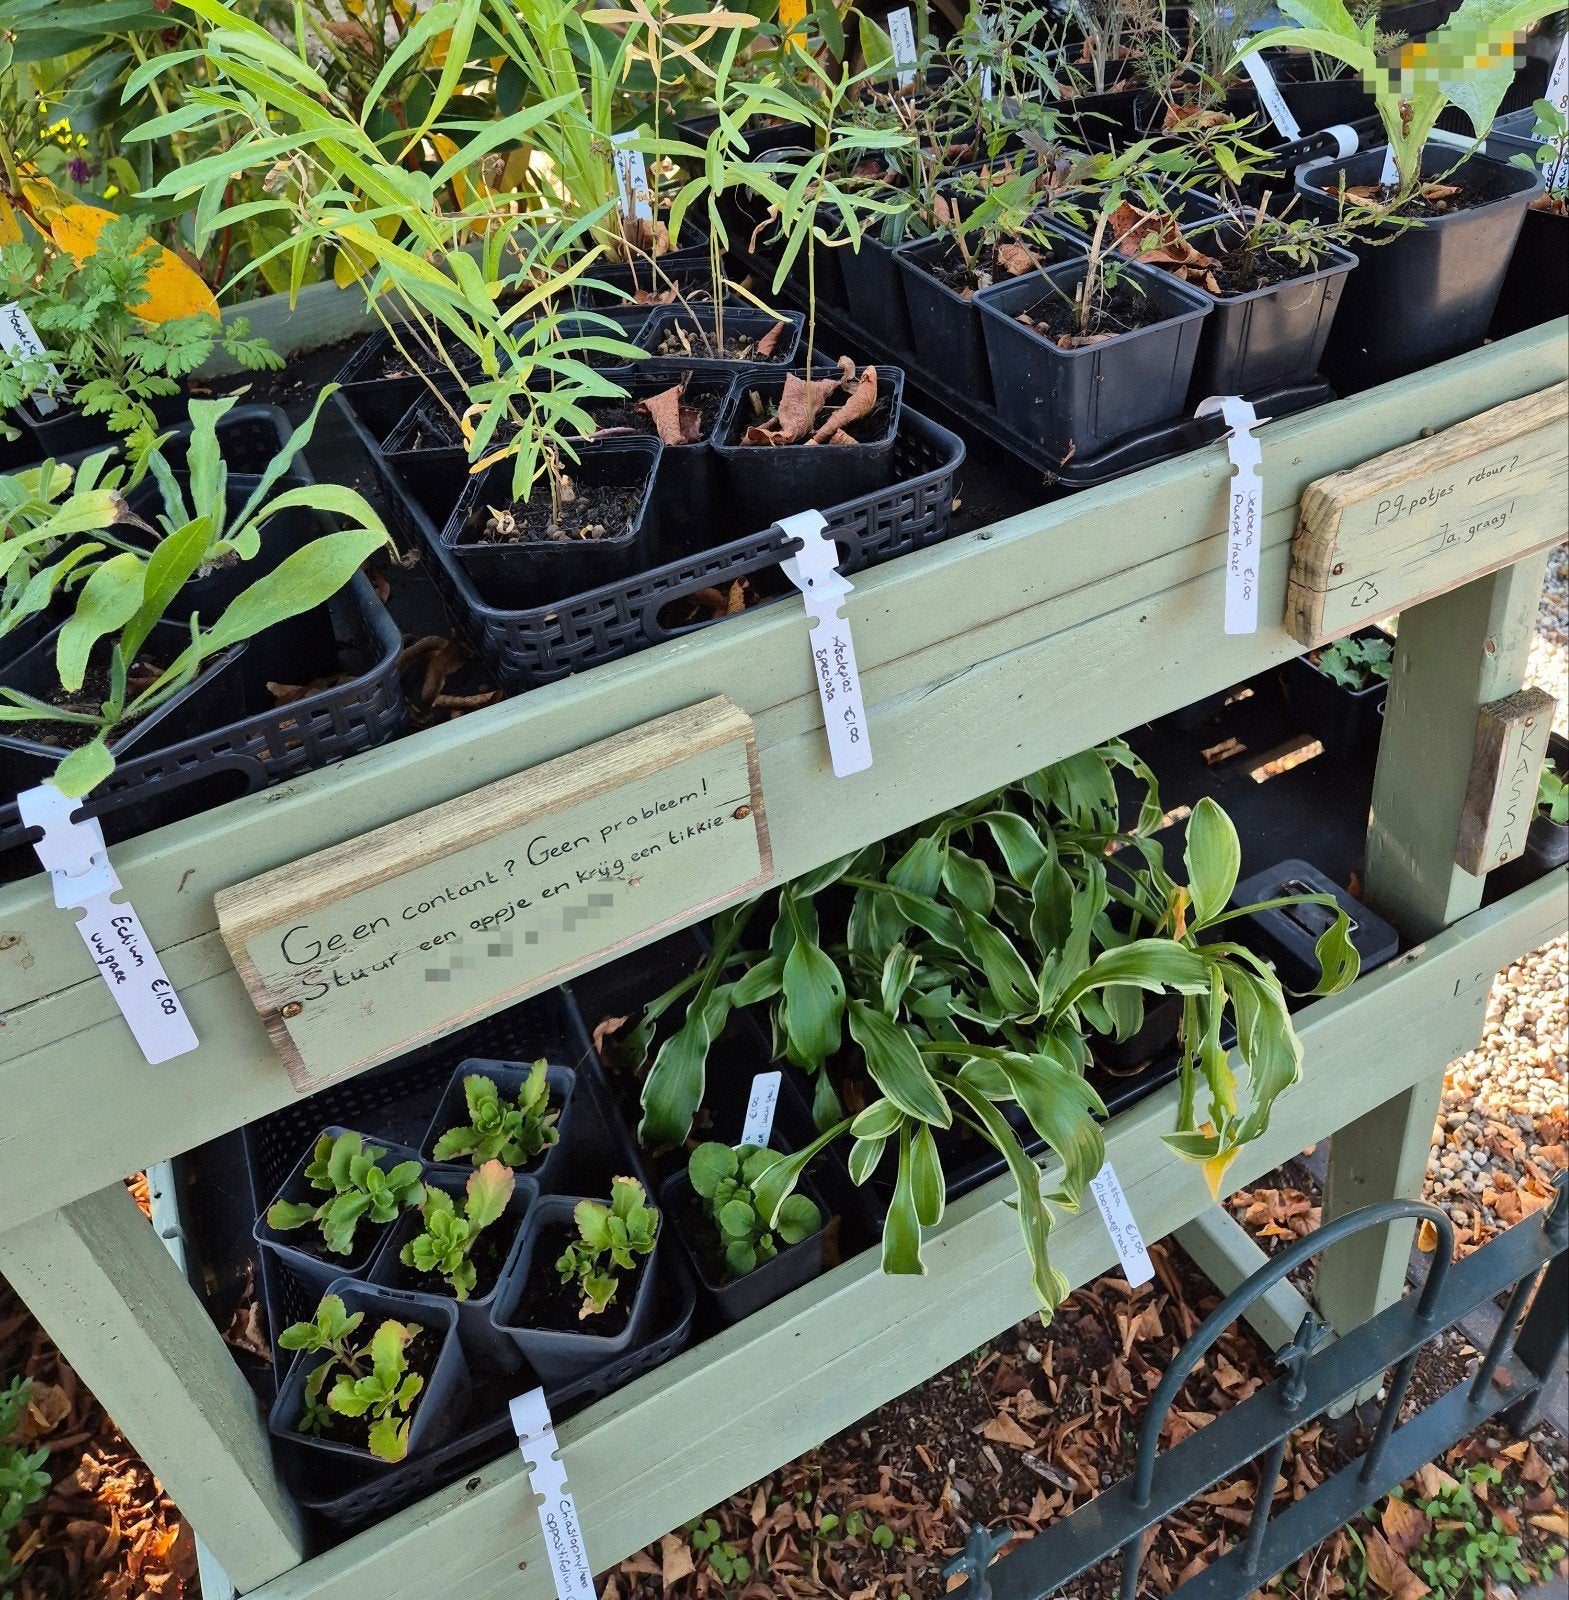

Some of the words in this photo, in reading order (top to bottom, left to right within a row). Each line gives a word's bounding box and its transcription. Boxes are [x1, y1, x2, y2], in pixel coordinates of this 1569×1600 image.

[1466, 455, 1520, 486] retour?
[1245, 489, 1258, 548] Verbena
[1464, 500, 1516, 544] graag!
[1494, 723, 1538, 856] KASSA
[280, 915, 391, 966] Geen
[526, 835, 590, 867] Geen
[599, 777, 708, 844] probleem!
[110, 916, 145, 968] Echium
[301, 950, 400, 1001] Stuur
[418, 929, 457, 952] een
[469, 897, 533, 930] appje
[541, 881, 571, 899] en
[630, 843, 662, 863] een
[90, 932, 127, 985] vulgare
